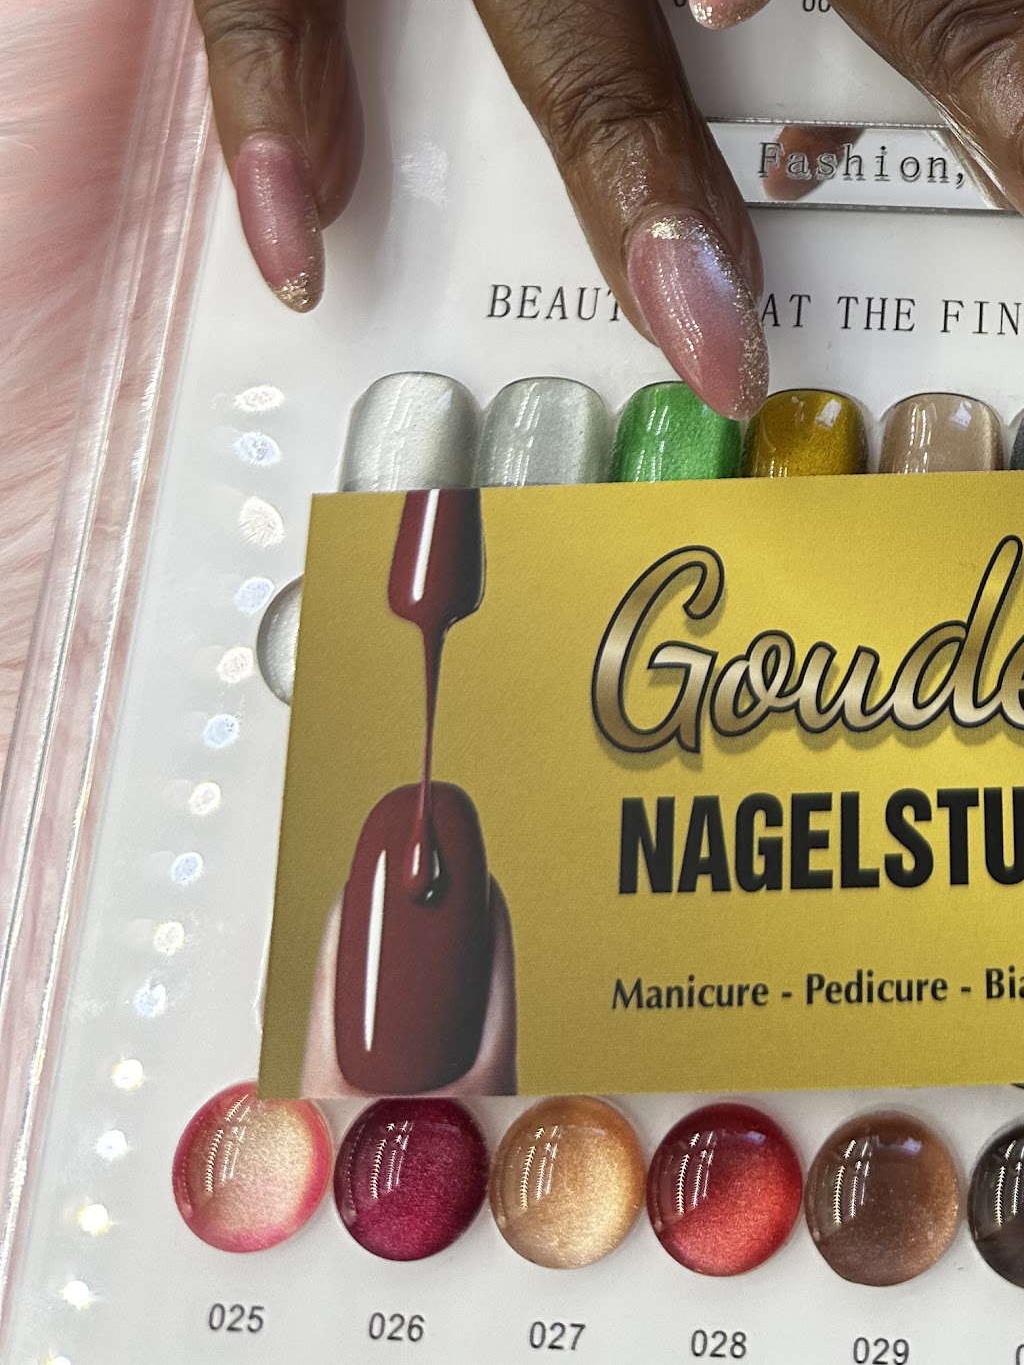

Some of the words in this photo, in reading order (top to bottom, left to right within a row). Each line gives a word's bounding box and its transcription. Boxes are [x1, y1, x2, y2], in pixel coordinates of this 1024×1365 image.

[757, 142, 966, 189] Fashion,
[487, 284, 621, 322] BEAUT
[762, 293, 811, 328] AT
[836, 296, 917, 332] THE
[611, 975, 770, 1011] Manicure
[806, 970, 949, 1006] Pedicure
[208, 1303, 265, 1334] 025
[368, 1312, 425, 1343] 026
[529, 1320, 586, 1351] 027
[690, 1329, 747, 1360] 028
[853, 1336, 910, 1365] 029
